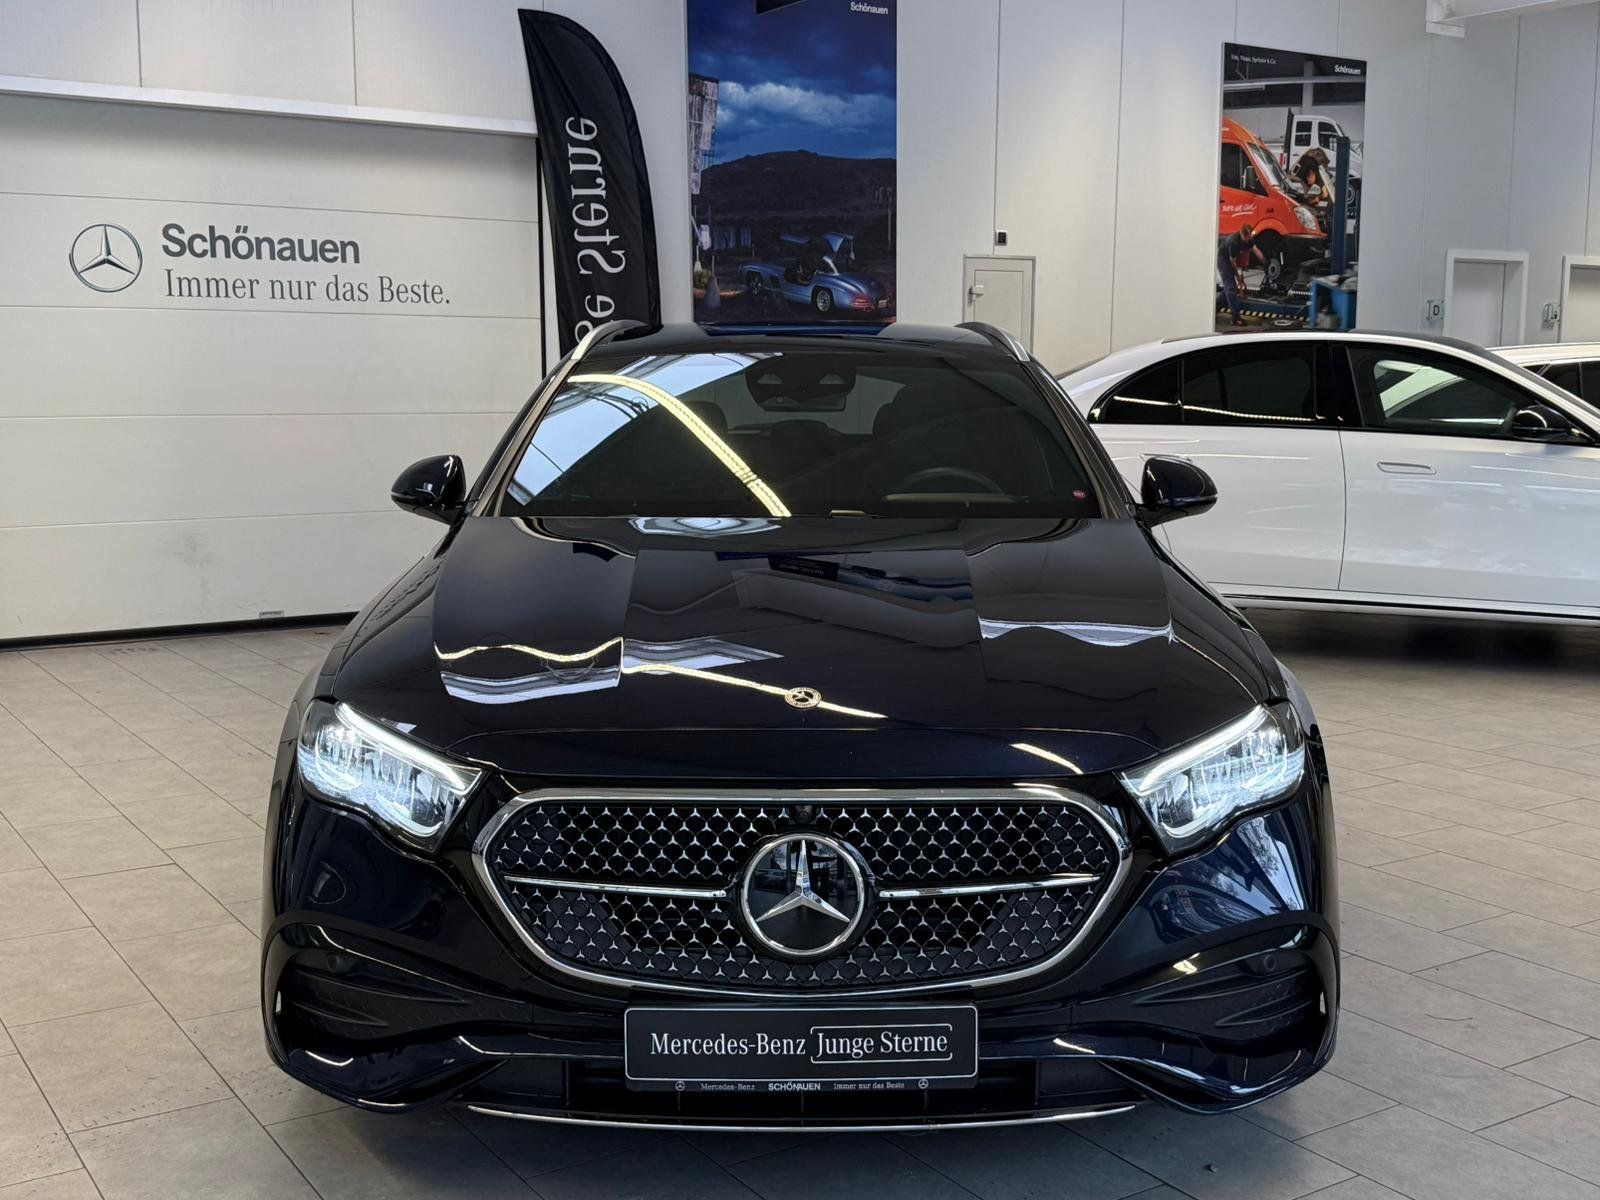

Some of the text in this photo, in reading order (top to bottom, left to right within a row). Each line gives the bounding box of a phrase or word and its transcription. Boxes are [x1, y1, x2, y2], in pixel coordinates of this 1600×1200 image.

[850, 1, 888, 15] Schönauen
[161, 223, 360, 264] Schönauen
[163, 268, 451, 305] Immer nur das Beste.
[650, 1031, 949, 1059] Mercedes-Benz Junge Sterne
[700, 1082, 756, 1092] Mercedes-Benz
[768, 1081, 821, 1092] SCHÖNAUEN
